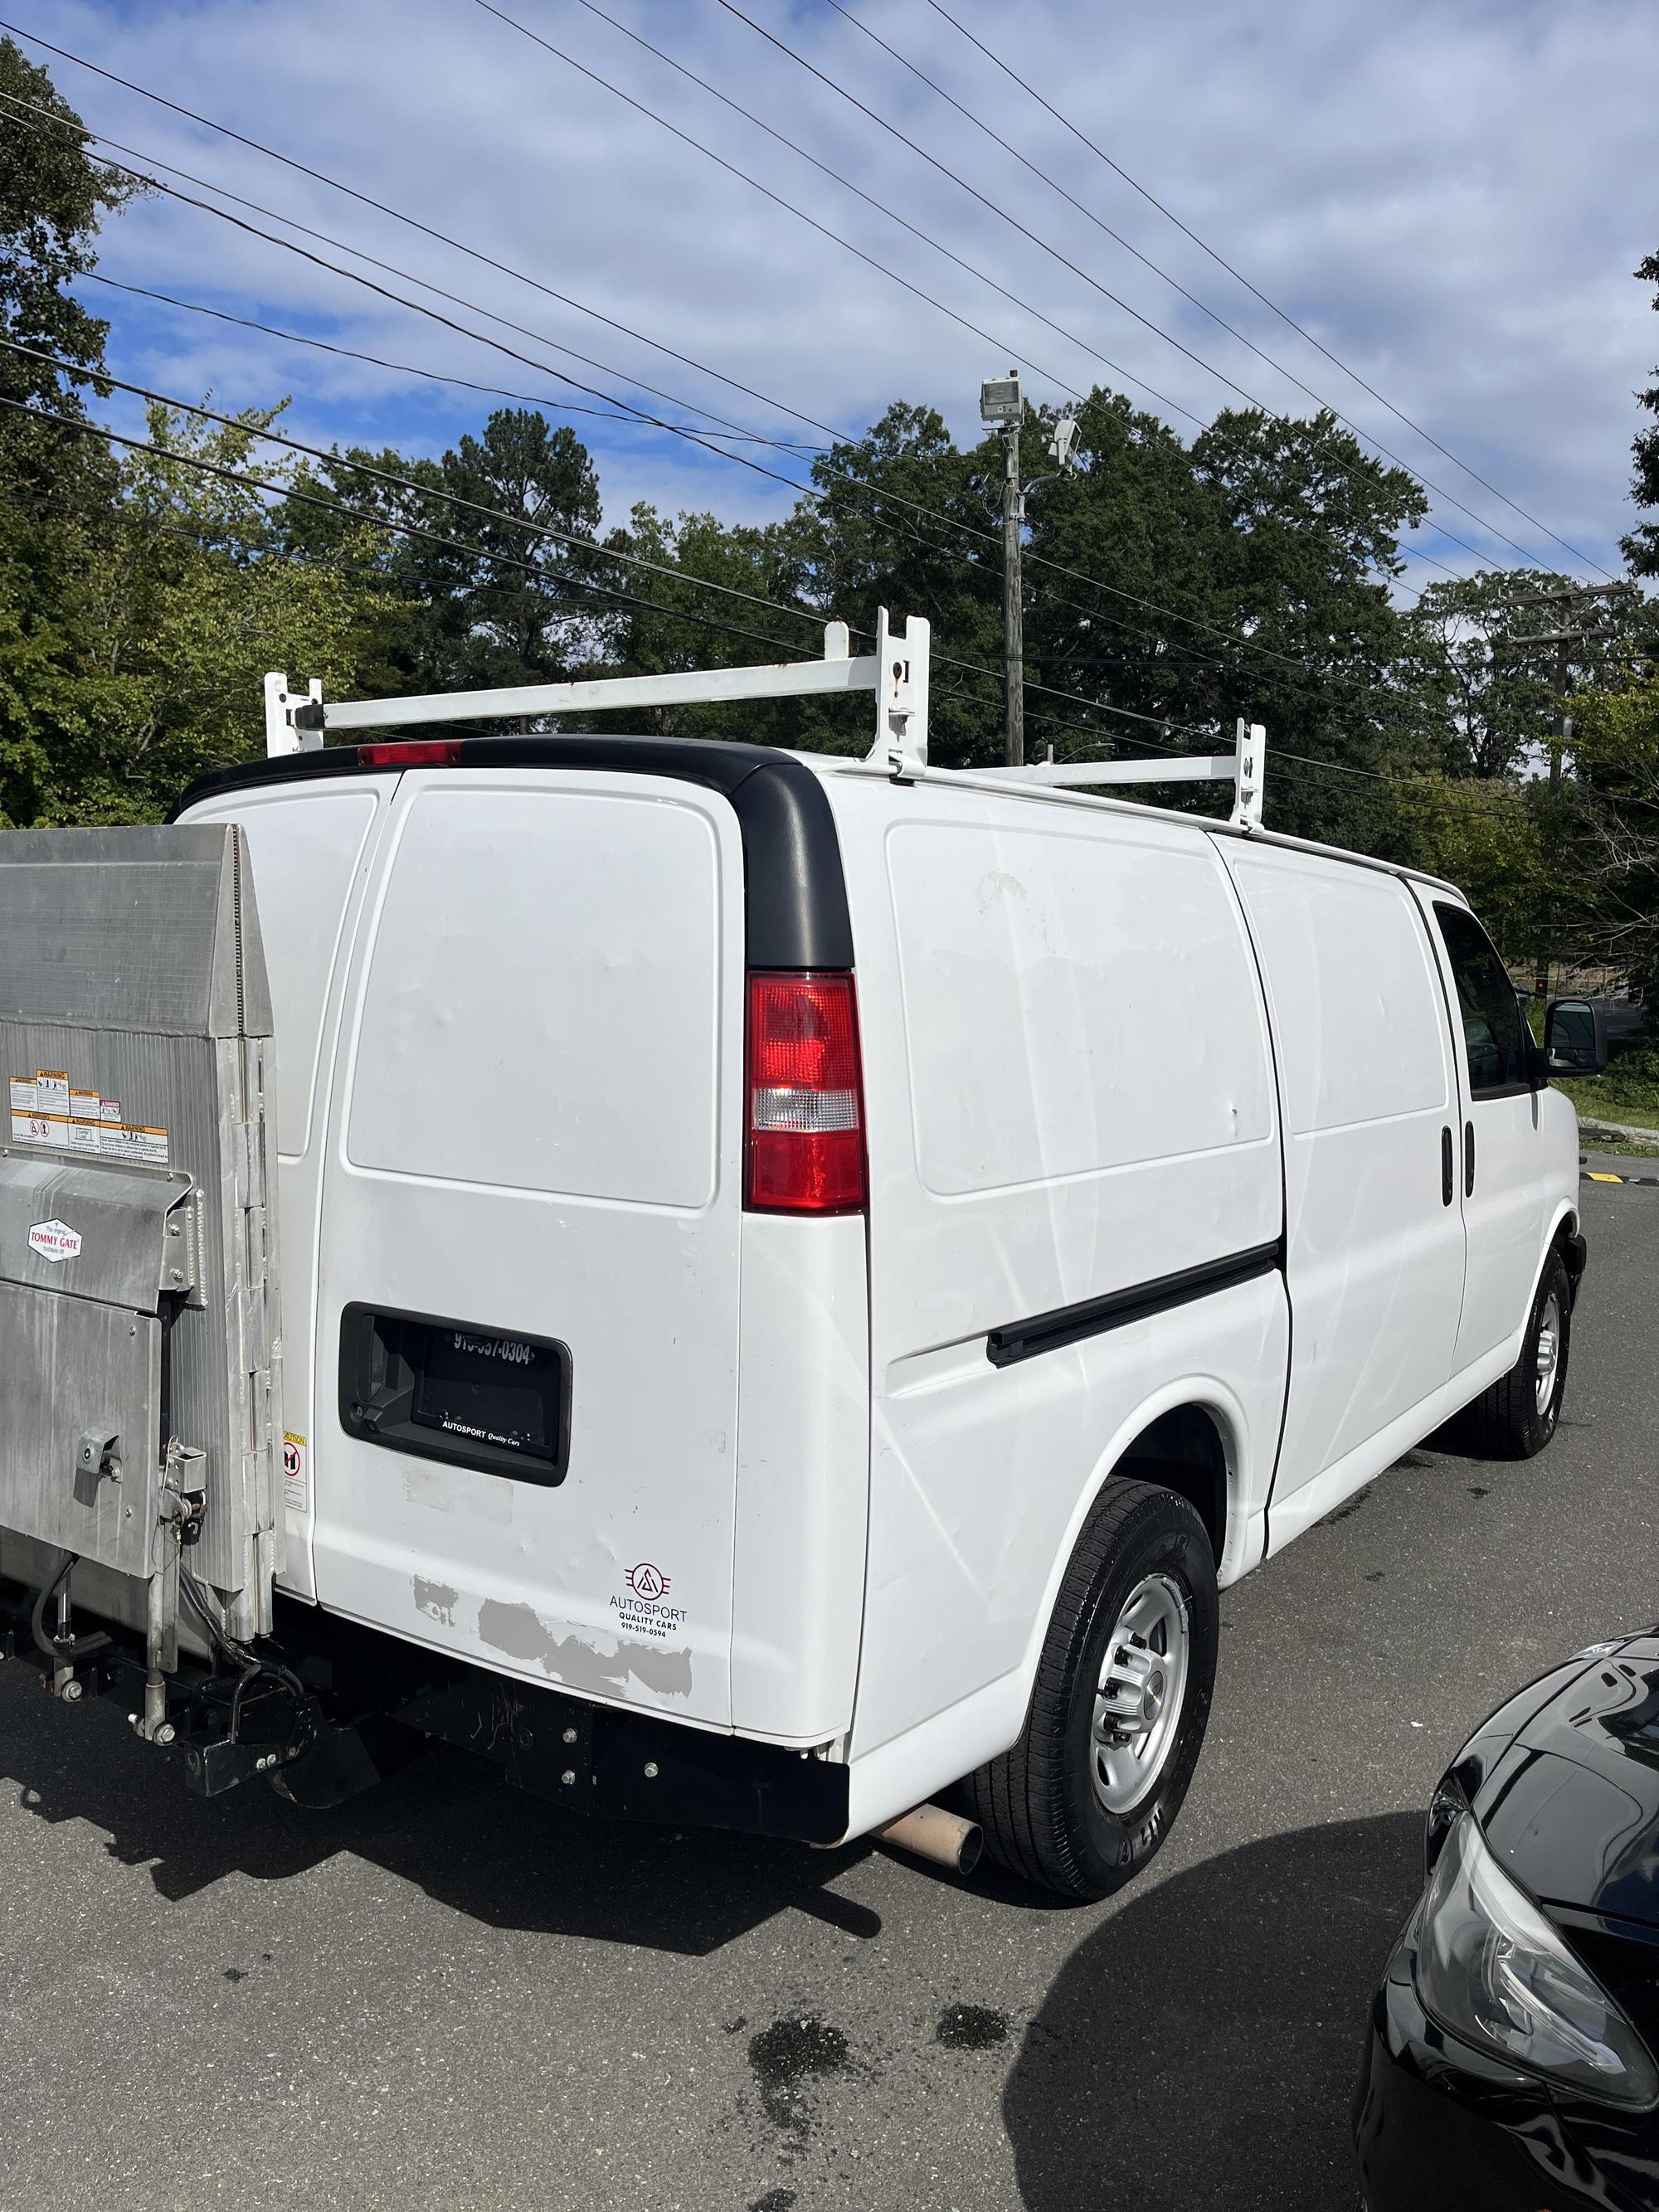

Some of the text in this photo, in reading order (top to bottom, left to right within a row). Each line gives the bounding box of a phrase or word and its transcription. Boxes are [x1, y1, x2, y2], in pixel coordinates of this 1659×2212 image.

[43, 1071, 66, 1079] WARNING
[32, 1232, 78, 1250] TOMMY GATE
[442, 1421, 520, 1446] AUTOSPORT Quality Cars
[610, 1596, 688, 1622] AUTOSPORT
[619, 1612, 677, 1631] QUALITY CARS
[621, 1622, 666, 1637] 919-519-0594
